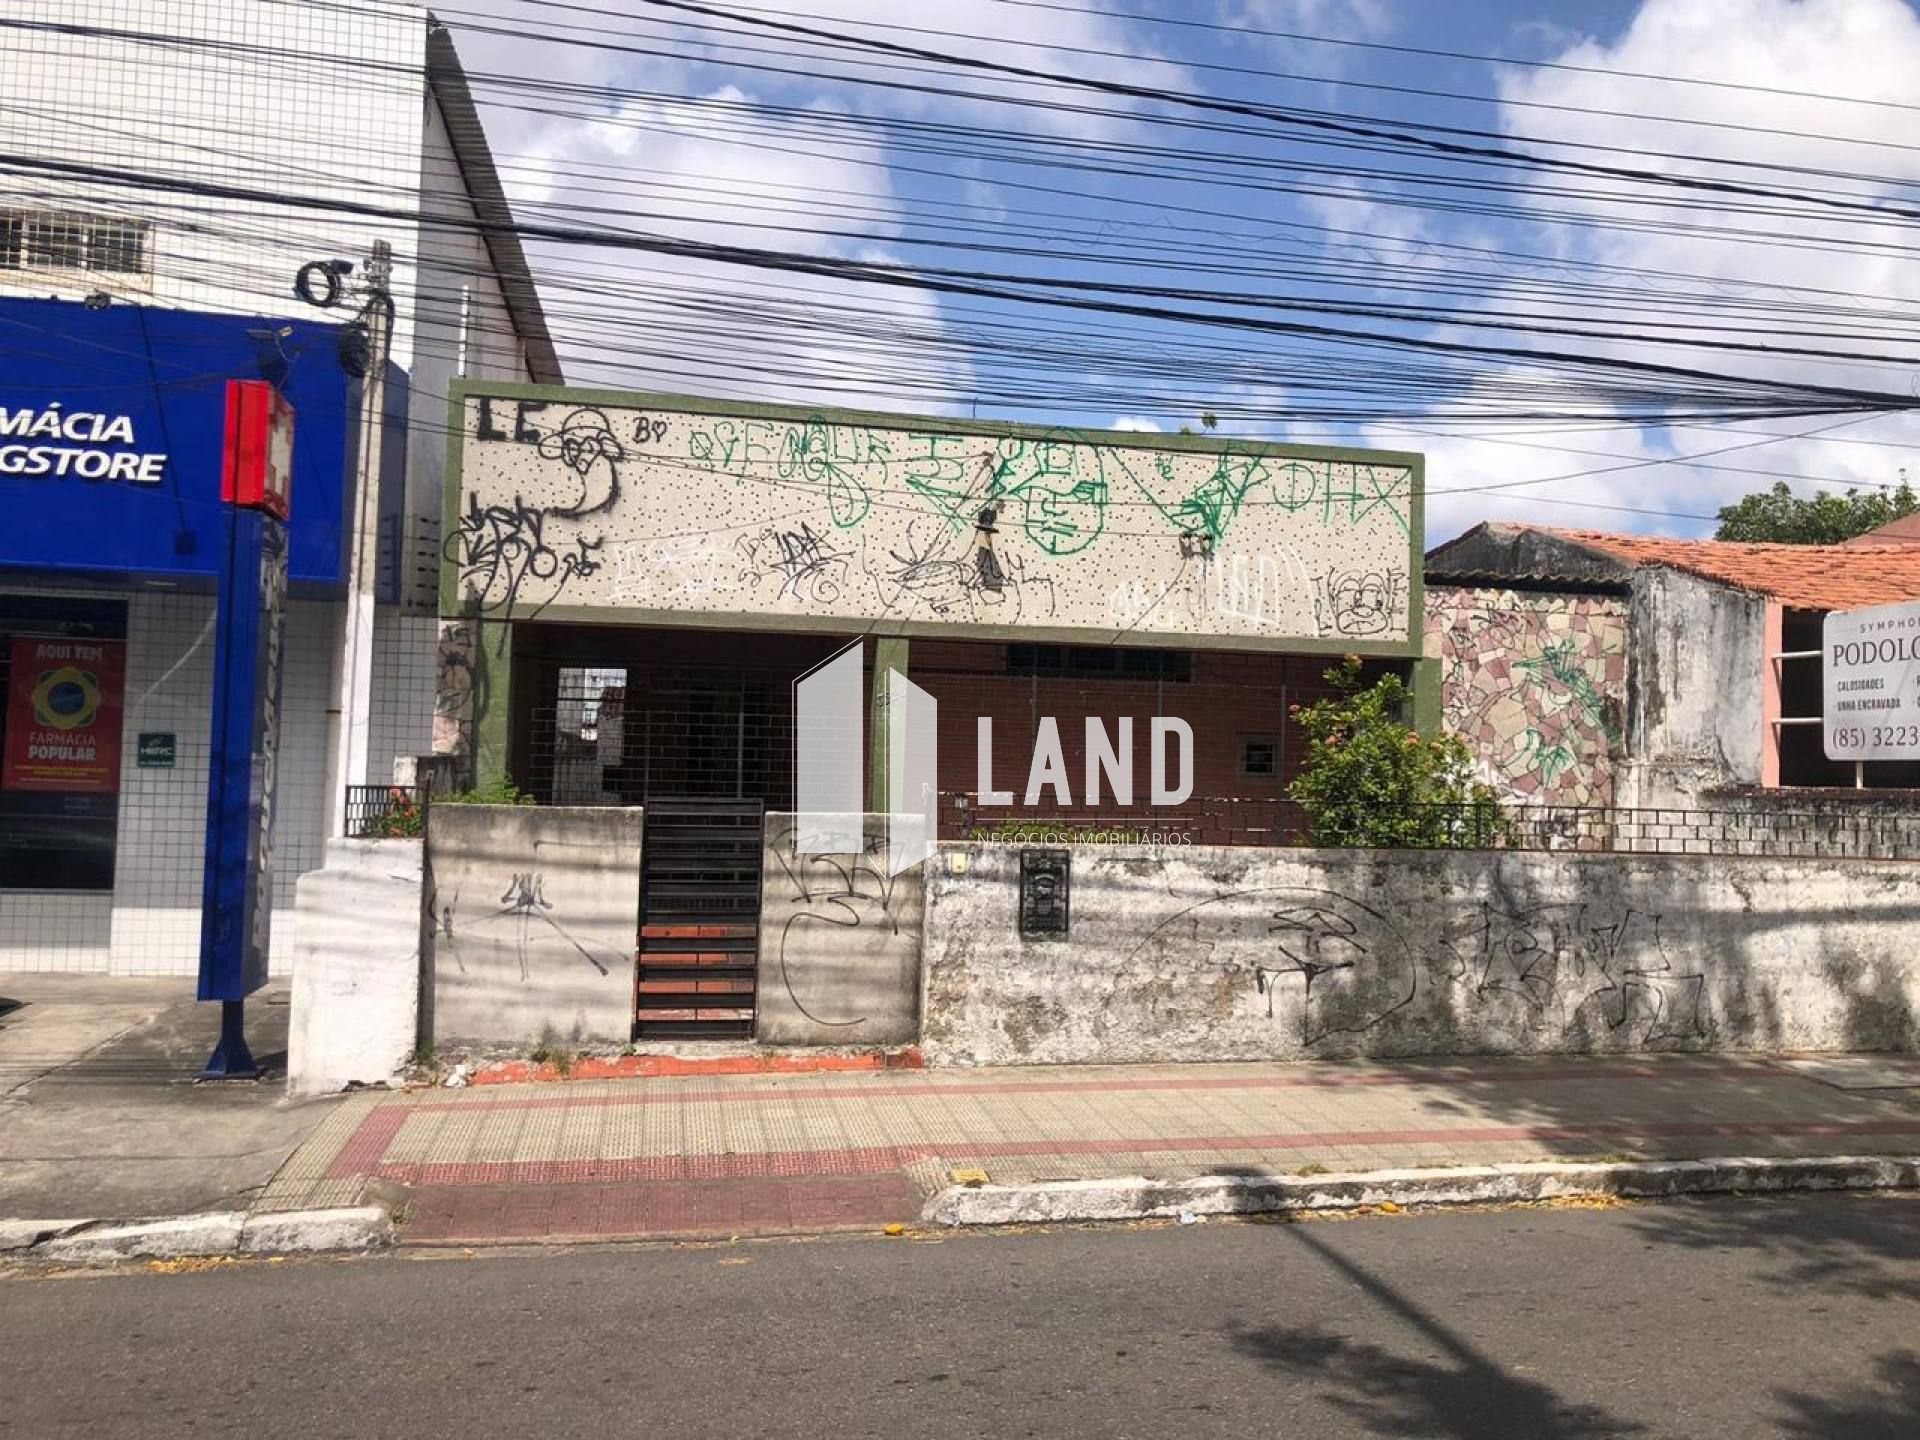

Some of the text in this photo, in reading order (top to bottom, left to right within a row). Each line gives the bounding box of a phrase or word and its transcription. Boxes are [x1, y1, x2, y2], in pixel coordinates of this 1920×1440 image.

[0, 401, 134, 444] MÁCIA
[1860, 617, 1920, 634] SYMPHO
[35, 643, 71, 661] AQUI
[1837, 678, 1884, 692] CALOSIDADES
[1837, 697, 1901, 712] UNHA ENCRAVADA
[1833, 728, 1866, 750] (85)
[27, 745, 97, 761] POPULAR
